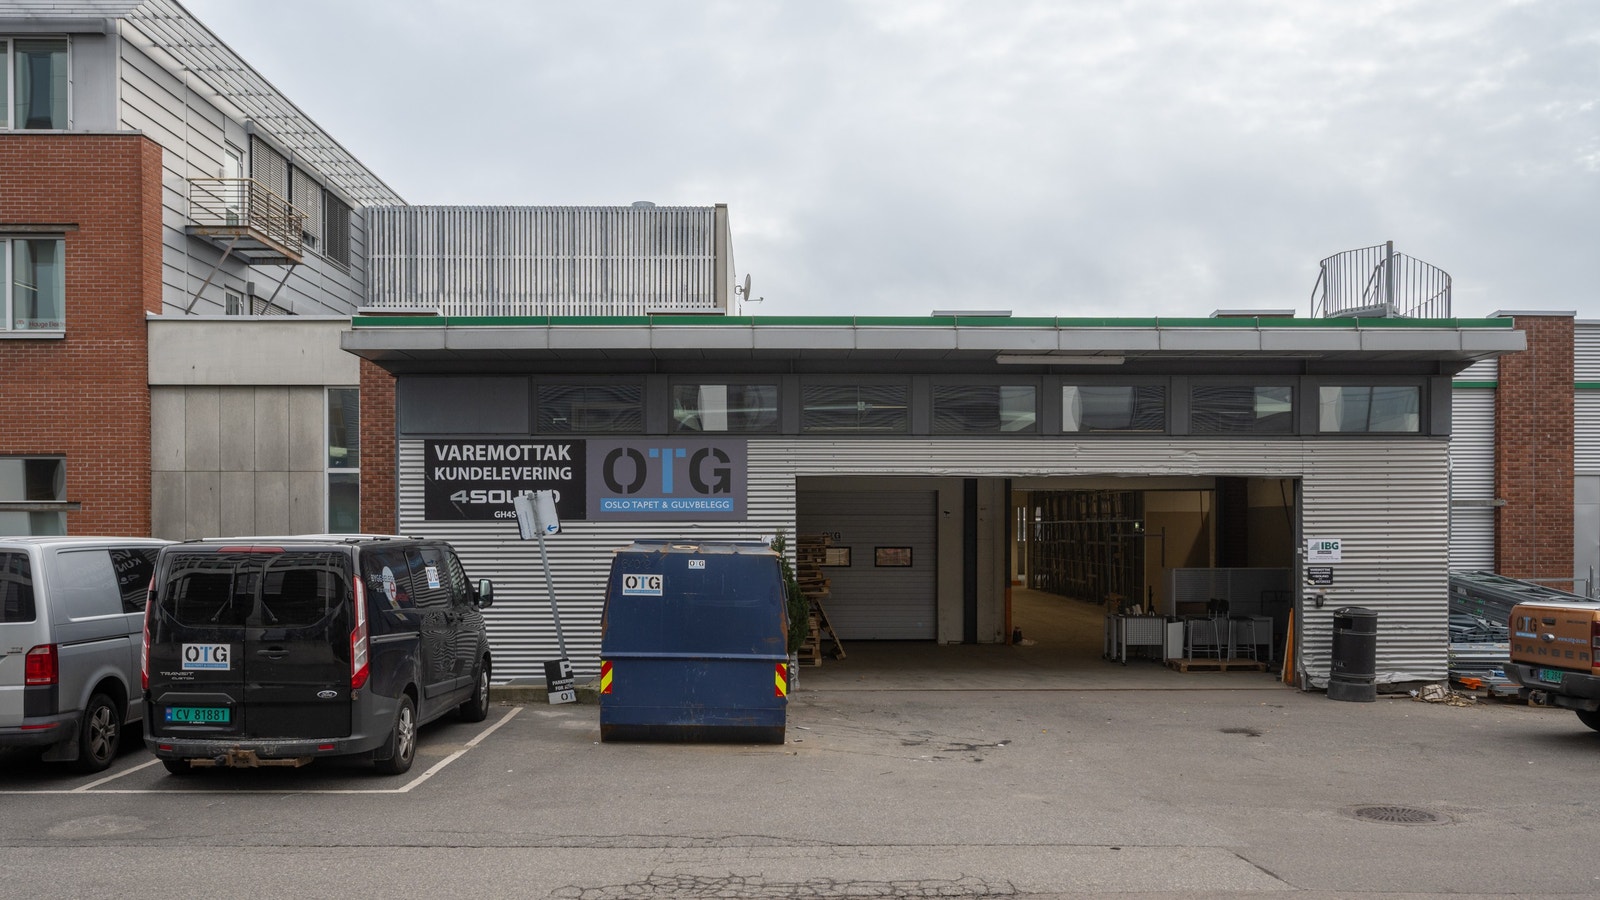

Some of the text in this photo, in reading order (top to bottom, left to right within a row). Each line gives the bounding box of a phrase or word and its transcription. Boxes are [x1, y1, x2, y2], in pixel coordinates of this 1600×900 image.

[434, 444, 572, 461] VAREMOTTAK
[434, 466, 573, 481] KUNDELEVERING
[602, 447, 732, 495] OTG
[604, 501, 730, 509] OSLO TAPET & GULVBELEGG
[1320, 541, 1339, 550] IBG
[625, 575, 661, 590] OTG
[1517, 616, 1537, 632] OTG
[185, 646, 227, 662] OTG
[1514, 644, 1589, 661] RANGER
[560, 661, 571, 677] P
[175, 709, 190, 721] CV
[194, 709, 226, 721] 81881
